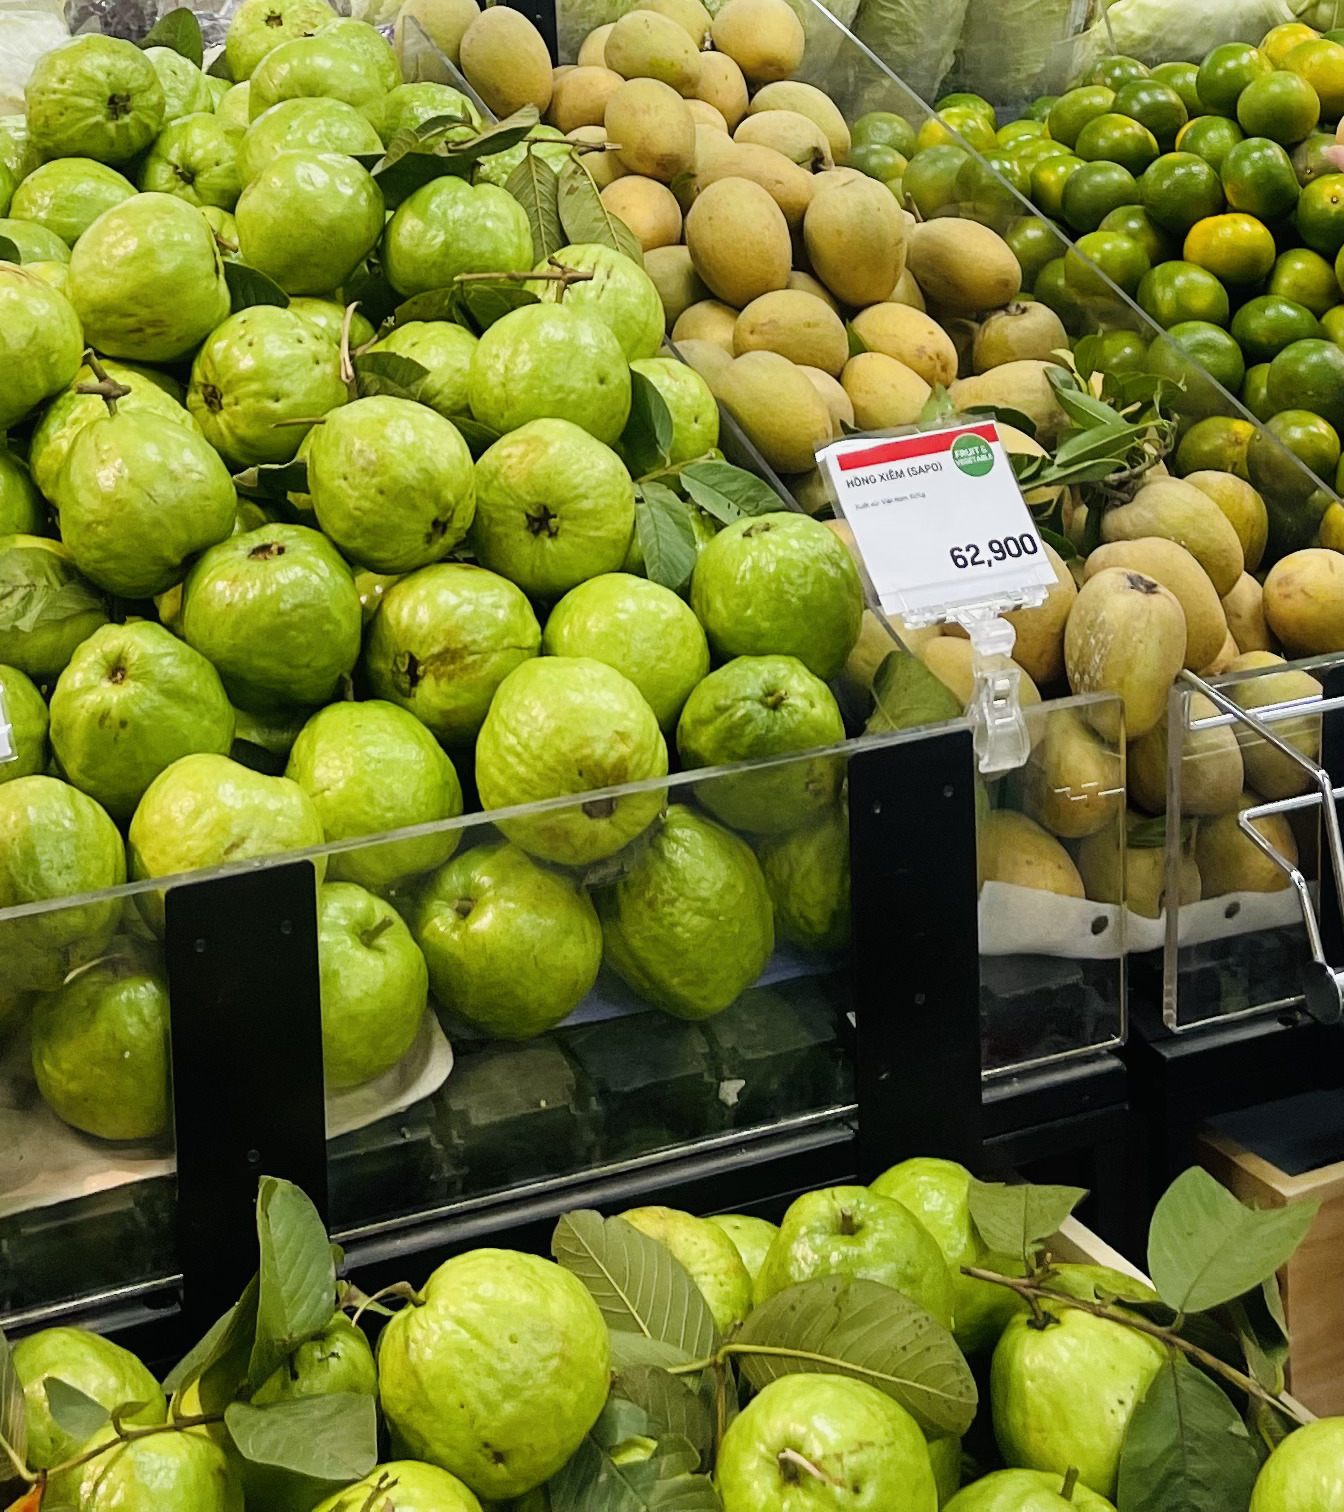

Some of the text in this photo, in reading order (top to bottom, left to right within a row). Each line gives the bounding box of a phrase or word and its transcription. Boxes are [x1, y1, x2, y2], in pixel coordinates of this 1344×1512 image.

[879, 467, 906, 483] XIÊM
[907, 461, 943, 478] (SAPO)
[949, 533, 1038, 569] 62,900
